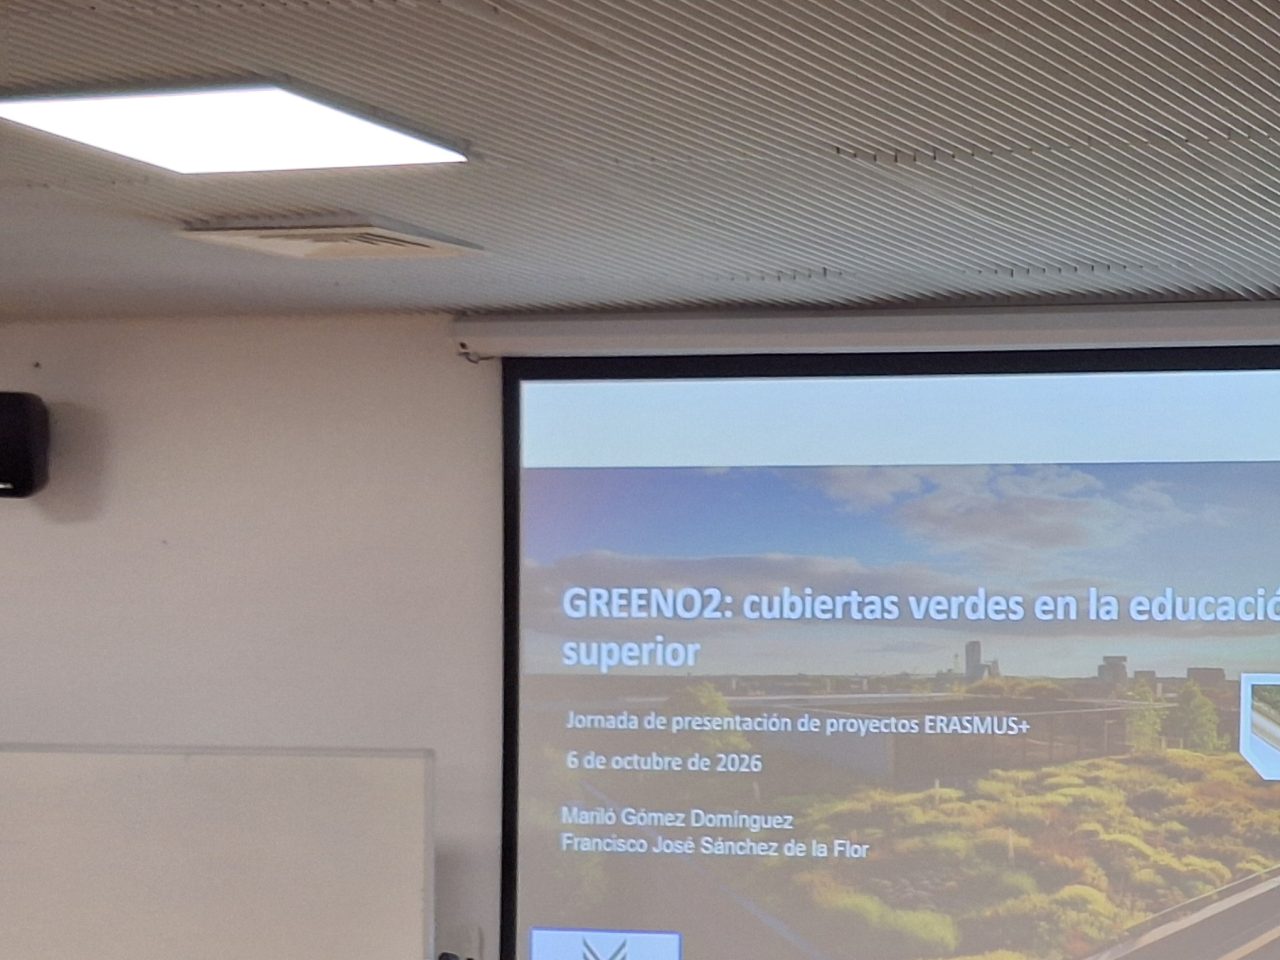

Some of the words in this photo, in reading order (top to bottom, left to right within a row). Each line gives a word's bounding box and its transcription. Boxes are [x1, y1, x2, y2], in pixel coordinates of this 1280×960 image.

[563, 587, 733, 619] GREENO2:
[743, 587, 899, 620] cubiertas
[909, 587, 1024, 620] verdes
[1034, 596, 1077, 620] en
[1089, 587, 1119, 621] la
[563, 635, 700, 673] superior
[566, 711, 638, 729] Jornada
[644, 712, 668, 730] de
[672, 713, 792, 733] presentación
[797, 714, 820, 732] de
[826, 716, 919, 736] proyectos
[924, 715, 1030, 735] ERASMUS+
[567, 751, 579, 769] 6
[583, 752, 607, 770] de
[611, 752, 682, 771] octubre
[688, 753, 711, 771] de
[716, 754, 762, 772] 2026
[561, 806, 616, 825] Mariló
[621, 807, 686, 827] Gómez
[691, 809, 794, 832] Domínguez
[561, 832, 648, 853] Francisco
[652, 836, 695, 853] José
[701, 836, 779, 856] Sánchez
[784, 838, 806, 857] de
[811, 839, 828, 857] la
[833, 839, 870, 858] Flor
